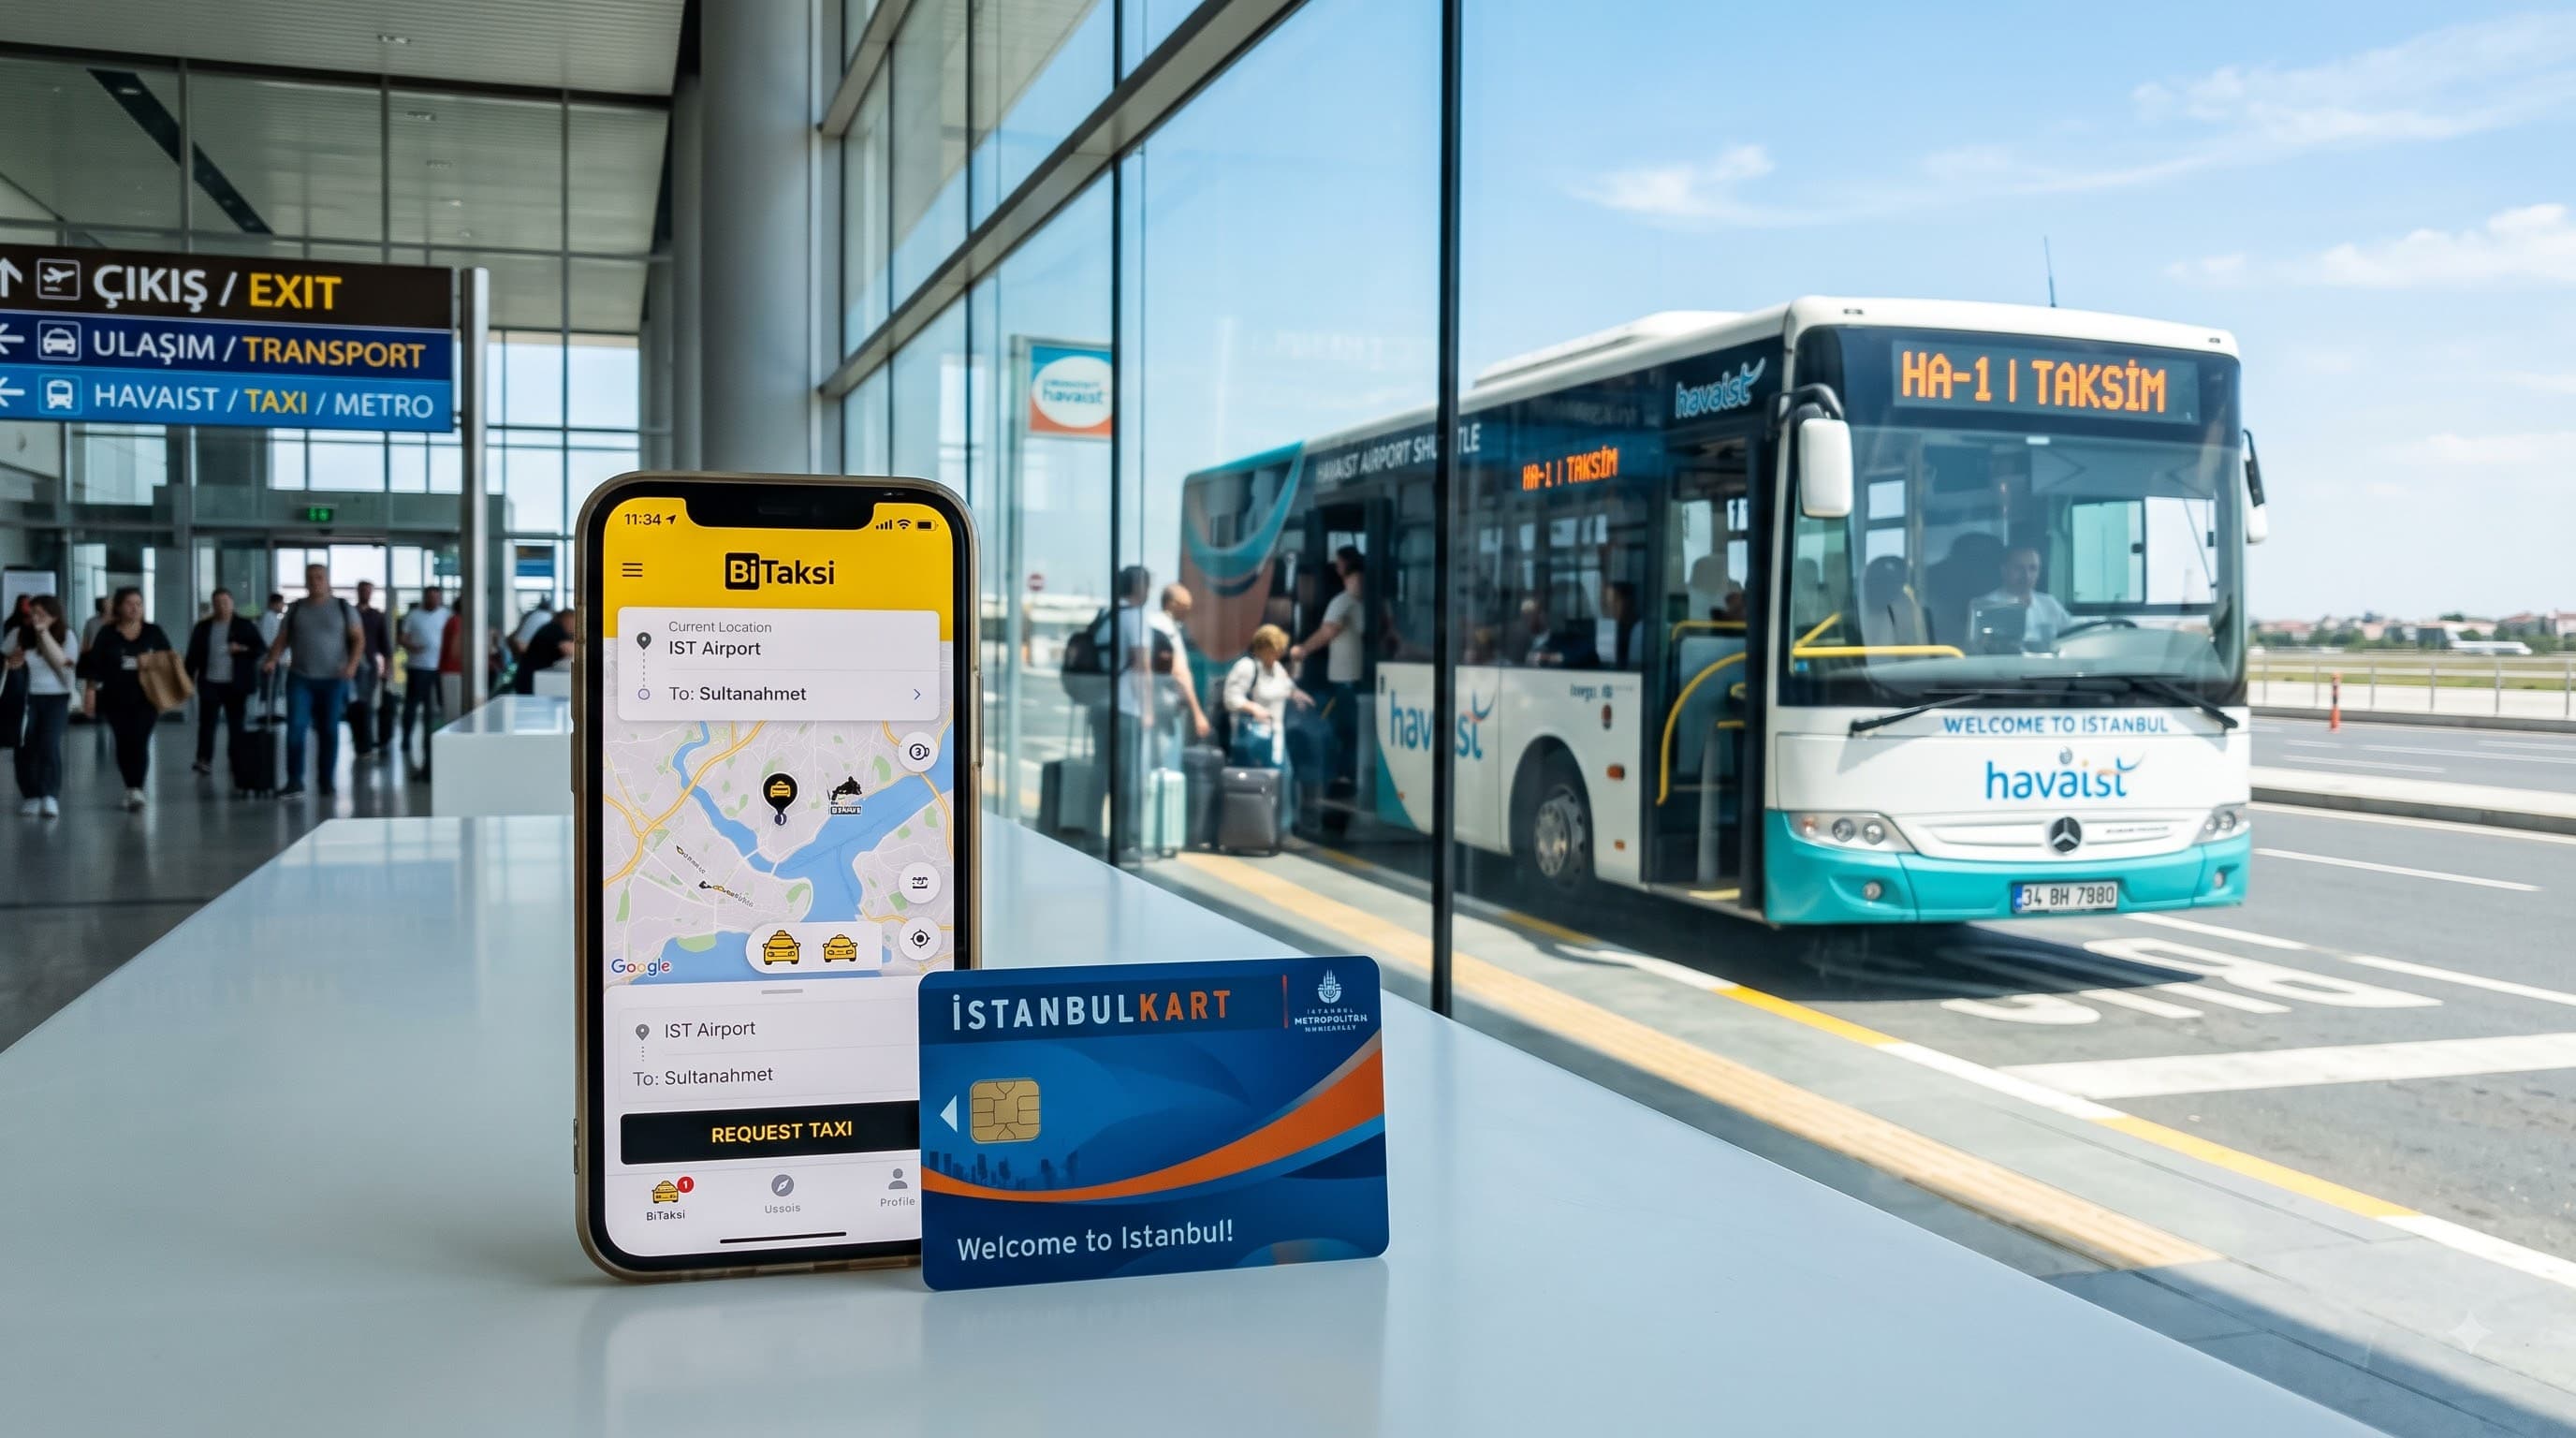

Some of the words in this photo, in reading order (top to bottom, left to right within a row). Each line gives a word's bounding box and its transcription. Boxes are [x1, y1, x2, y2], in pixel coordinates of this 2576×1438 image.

[94, 265, 208, 312] ÇIKIŞ
[249, 273, 342, 309] EXIT
[95, 331, 214, 364] ULAŞIM
[242, 336, 425, 368] TRANSPORT
[1902, 351, 1991, 402] HA-1
[2032, 360, 2166, 413] TAKSİM
[95, 385, 220, 412] HAVAIST
[244, 389, 306, 414] TAXI
[334, 393, 433, 418] METRO
[1360, 439, 1412, 474] AIRPORT
[1413, 423, 1481, 462] SHUTLE
[1523, 461, 1552, 491] HA-1
[1567, 445, 1618, 484] TAKSİM
[624, 513, 662, 525] 11:34
[728, 558, 835, 585] BiTaksi
[668, 621, 716, 633] Current
[719, 622, 772, 634] Location
[669, 641, 697, 655] IST
[702, 641, 761, 659] Airport
[669, 687, 695, 701] To:
[699, 686, 807, 702] Sultanahmet
[1391, 689, 1497, 760] havst
[1943, 716, 2044, 733] WELCOME
[2052, 716, 2075, 732] TO
[2082, 716, 2169, 732] ISTANBUL
[1985, 751, 2145, 800] havaist
[2023, 888, 2042, 906] 34
[2050, 888, 2069, 905] BH
[2077, 886, 2115, 904] 7980
[611, 959, 670, 976] Google
[665, 1023, 692, 1038] IST
[696, 1021, 755, 1040] Airport
[633, 1071, 659, 1087] To:
[665, 1067, 773, 1086] Sultanahmet
[711, 1123, 803, 1143] REQUEST
[809, 1121, 853, 1137] TAXI
[764, 1203, 801, 1214] Ussois
[880, 1196, 915, 1208] Profile
[646, 1211, 685, 1221] BiTaksi
[958, 1236, 1077, 1261] Welcome
[1086, 1230, 1112, 1252] to
[1122, 1219, 1233, 1250] Istanbul!
